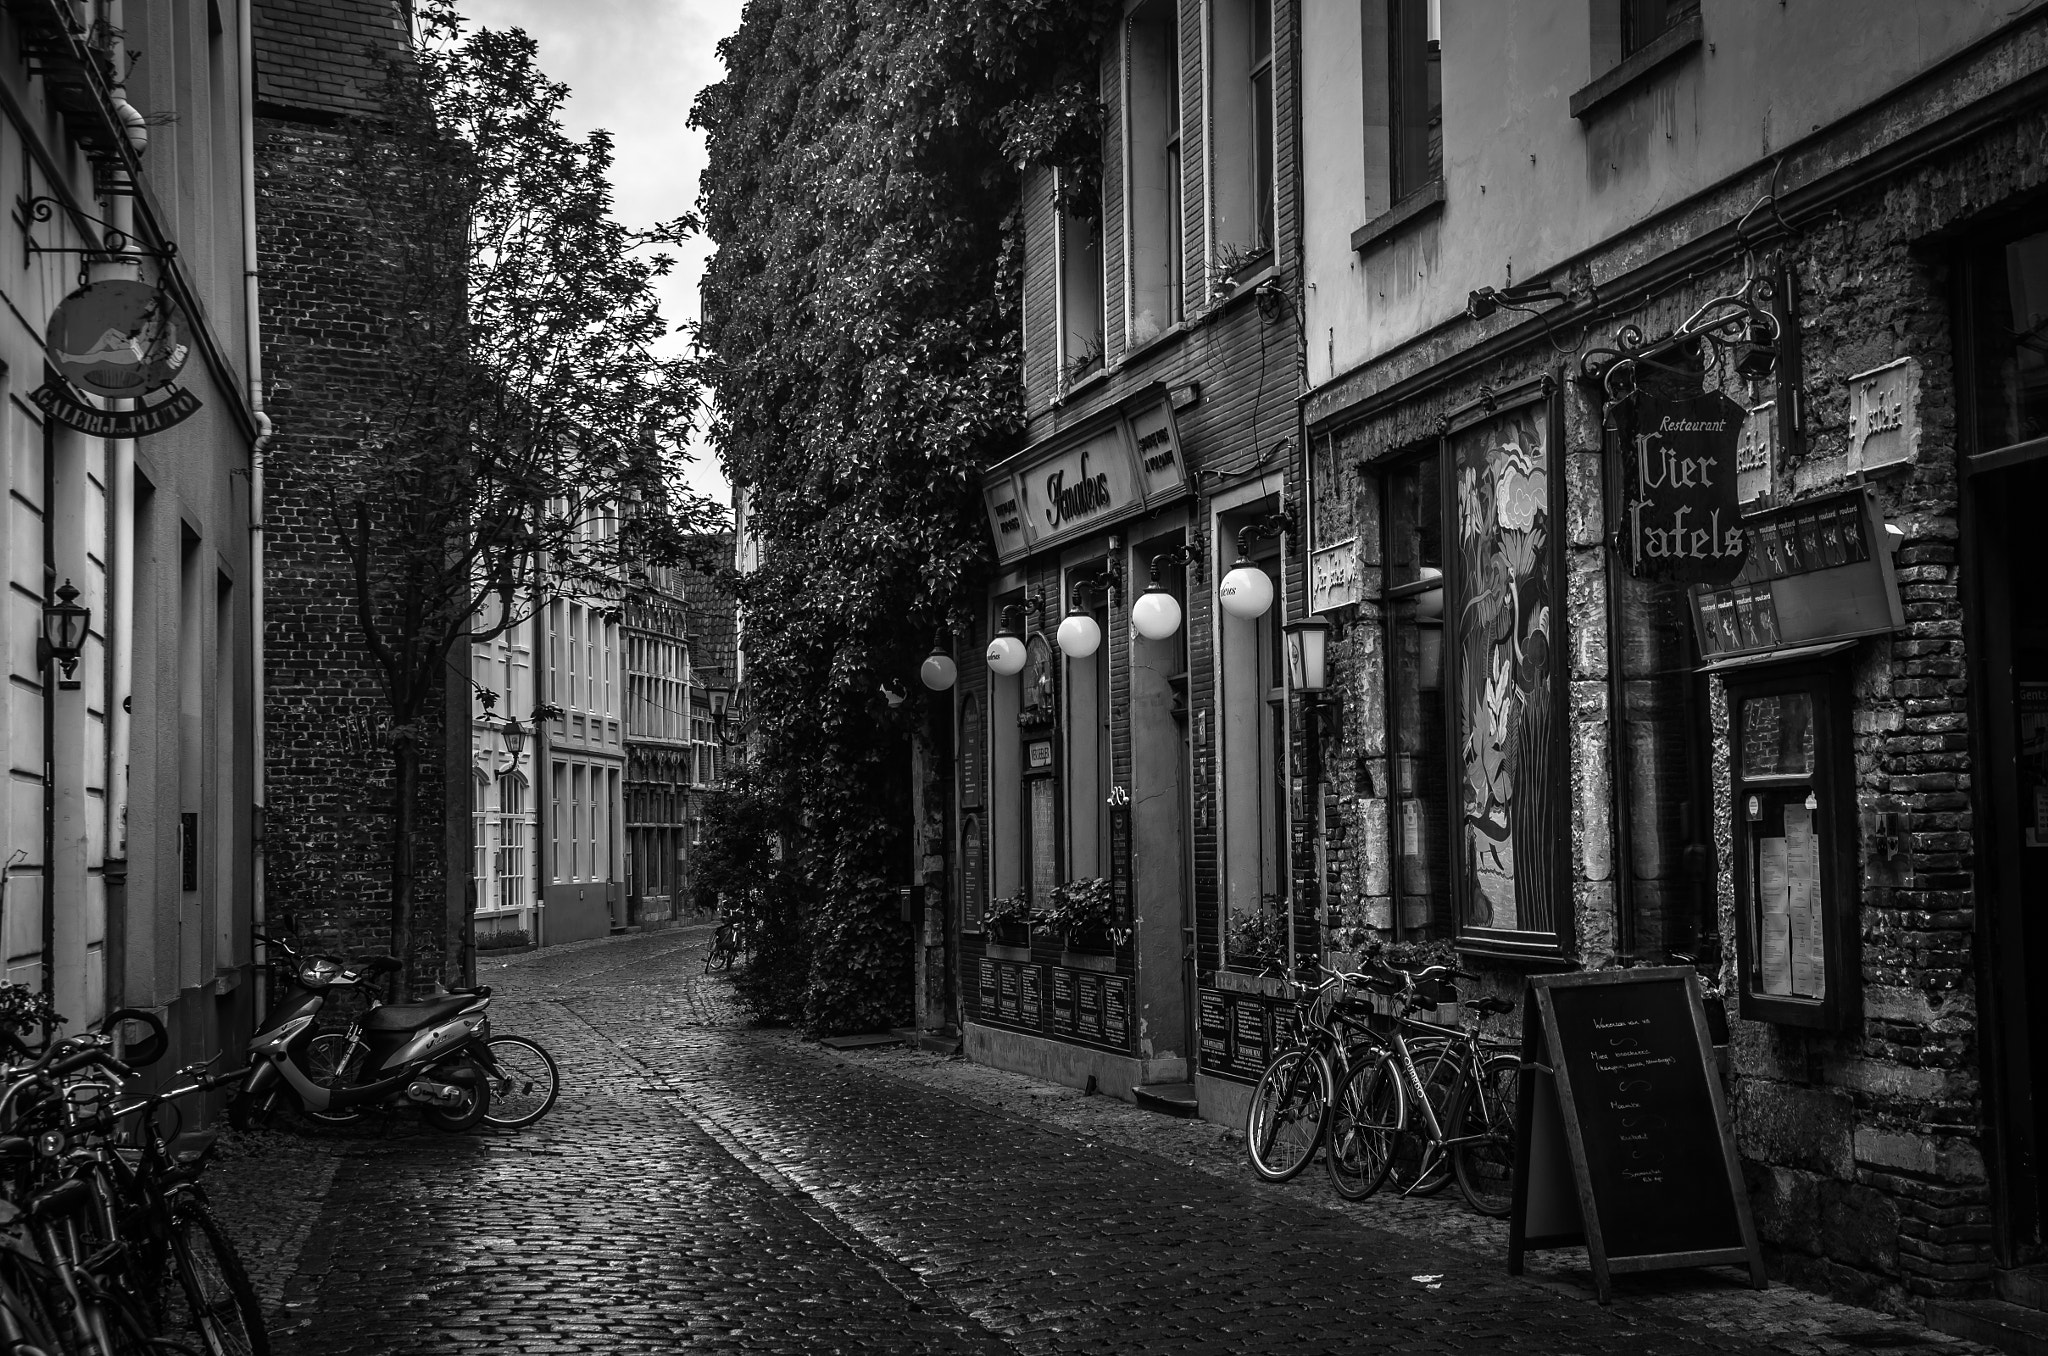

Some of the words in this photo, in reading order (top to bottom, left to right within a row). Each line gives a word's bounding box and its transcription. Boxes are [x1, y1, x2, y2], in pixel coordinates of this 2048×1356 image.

[37, 388, 116, 434] GALERIJ
[129, 395, 194, 433] PLUTO
[1659, 415, 1727, 433] Restaurant
[1046, 452, 1110, 526] Amadeus
[1635, 431, 1718, 501] Vier
[1628, 500, 1743, 577] Tafels
